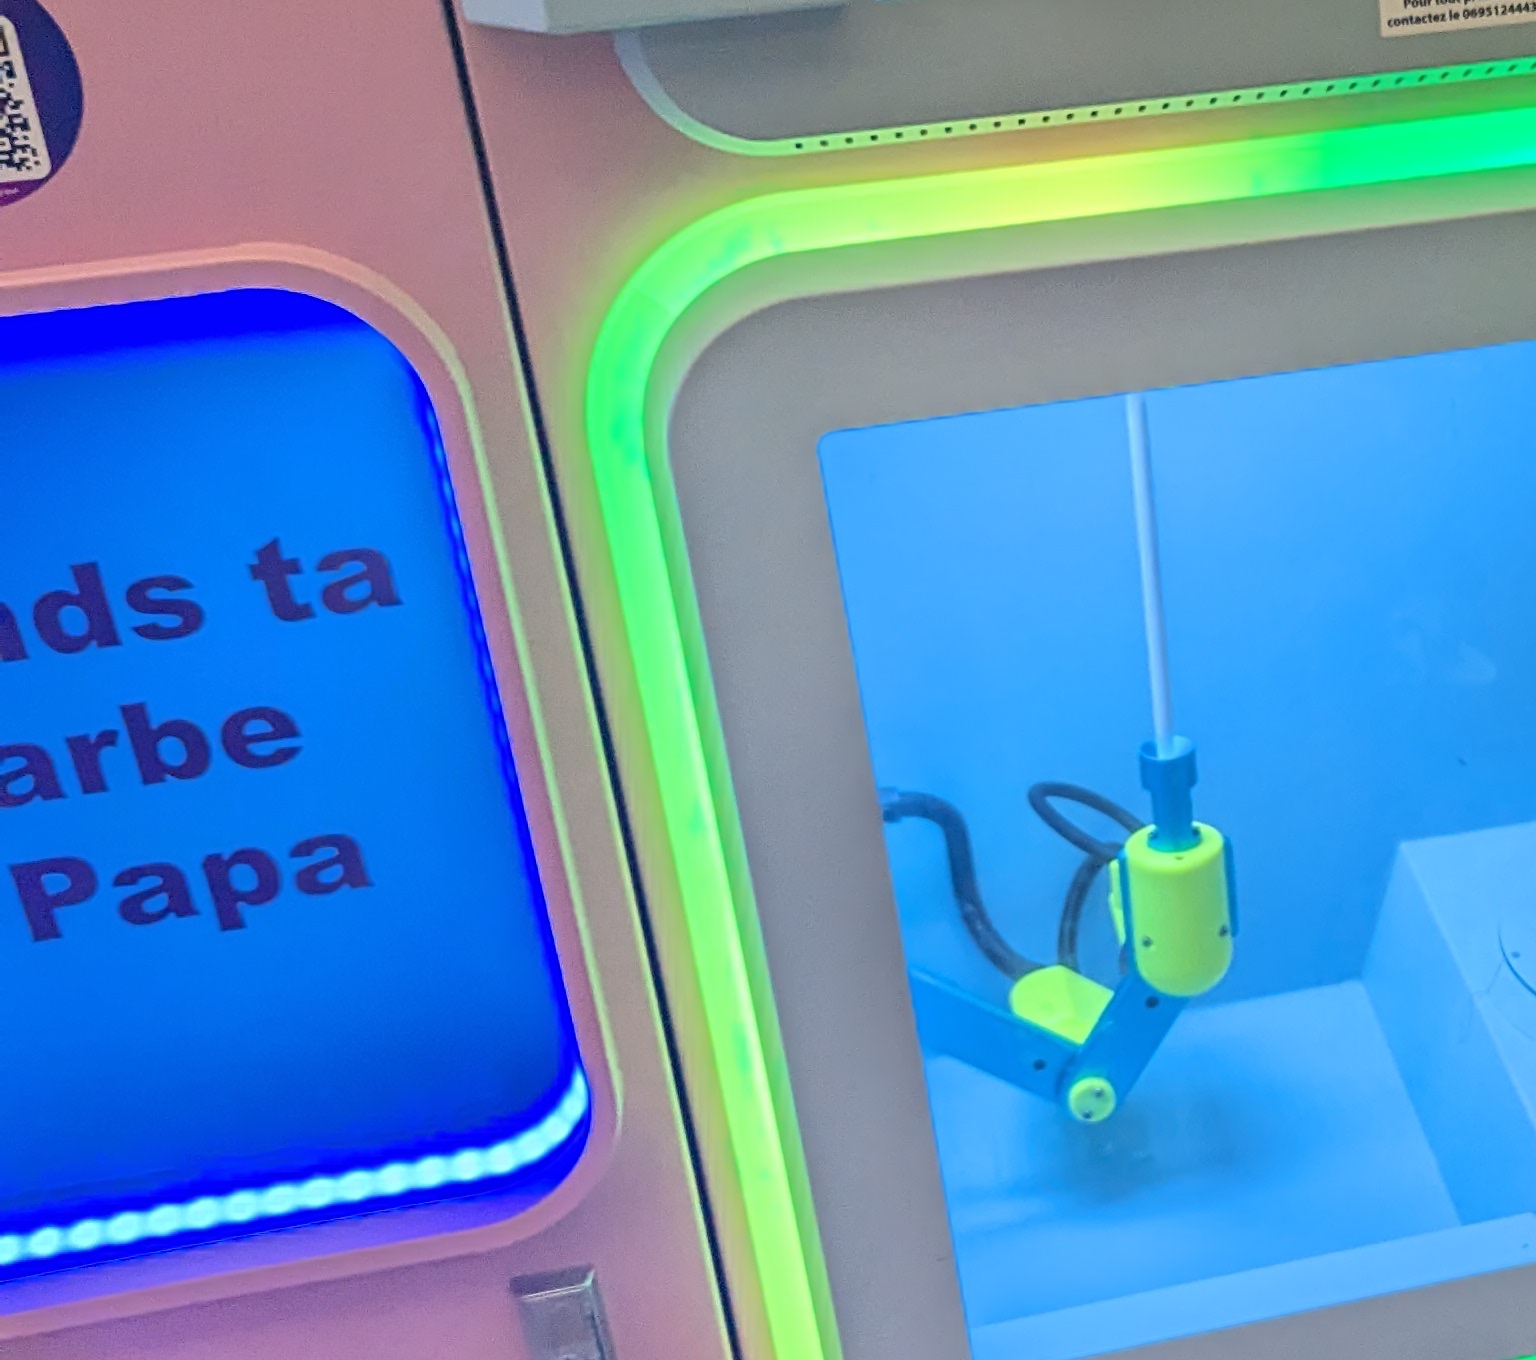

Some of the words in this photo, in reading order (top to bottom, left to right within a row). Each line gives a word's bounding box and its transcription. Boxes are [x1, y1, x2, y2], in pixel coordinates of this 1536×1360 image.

[1386, 11, 1447, 28] contactez
[1449, 9, 1460, 21] le
[247, 537, 404, 623] ta
[8, 832, 375, 943] Papa
